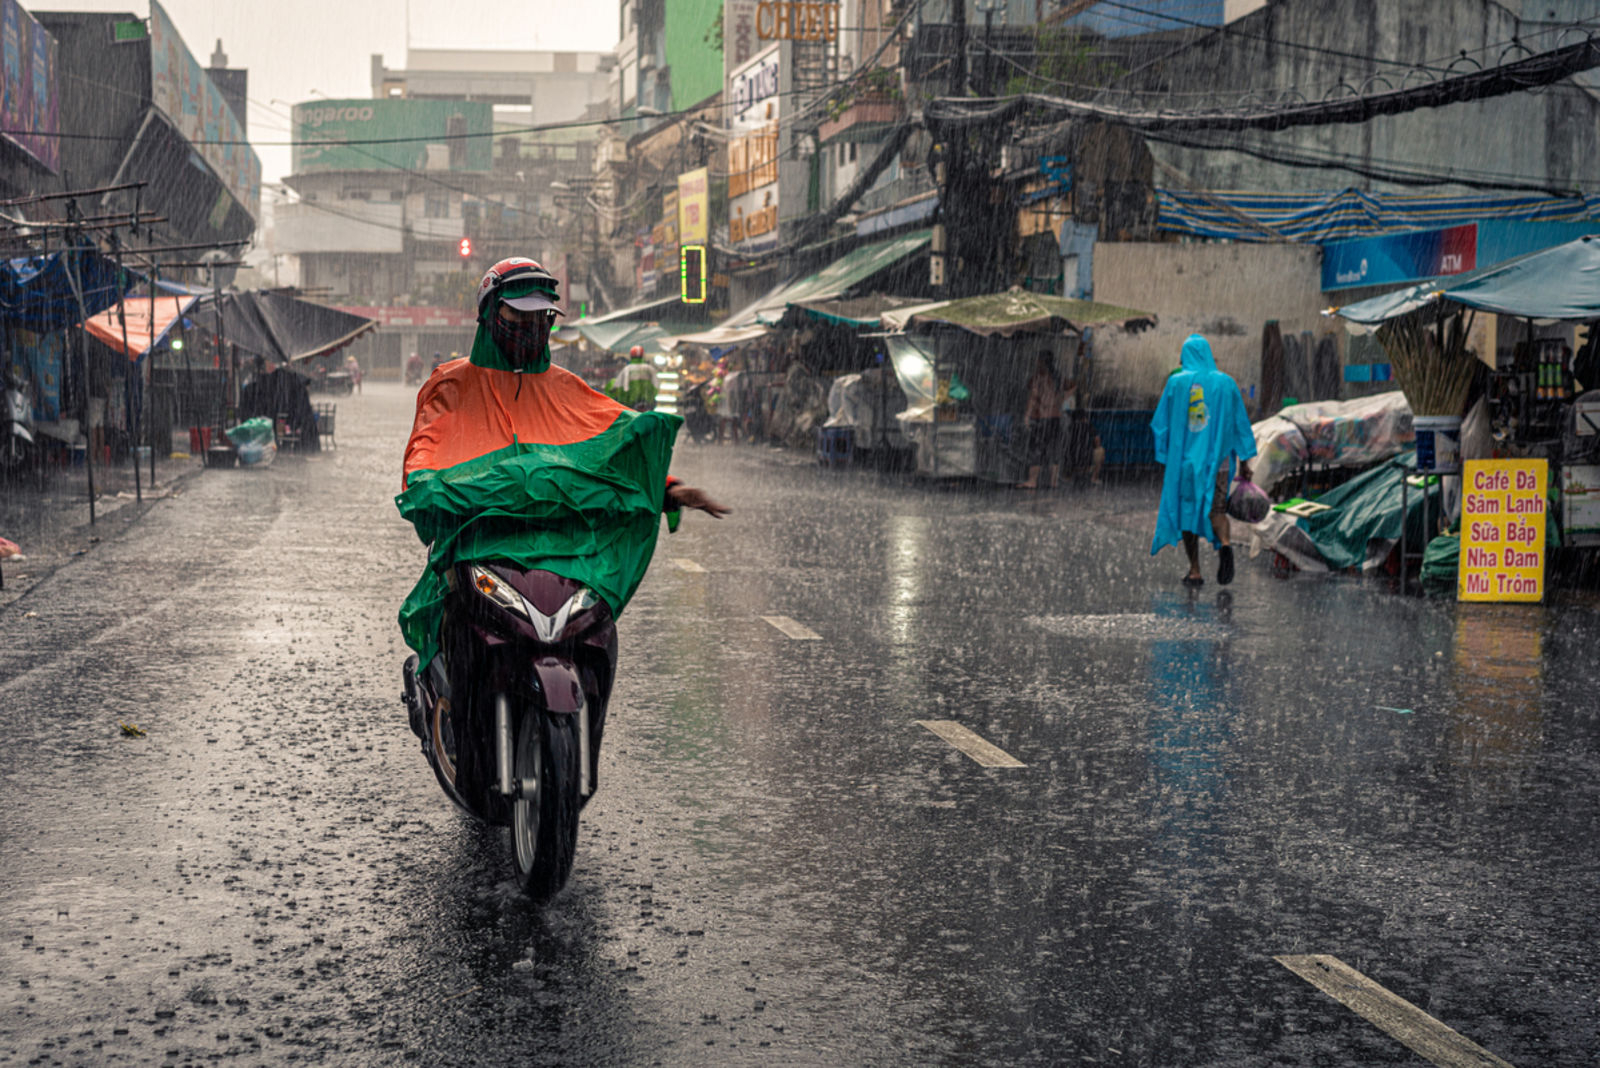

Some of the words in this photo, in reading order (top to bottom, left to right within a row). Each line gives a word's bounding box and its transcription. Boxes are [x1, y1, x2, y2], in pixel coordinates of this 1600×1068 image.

[1440, 254, 1462, 272] ATM
[1474, 470, 1509, 490] Café
[1516, 469, 1536, 490] Đá
[1466, 494, 1499, 513] Sâm
[1506, 494, 1543, 518] Lạnh
[1471, 522, 1499, 542] Sữa
[1507, 516, 1536, 547] Bắp
[1467, 548, 1497, 568] Nha
[1504, 548, 1538, 568] Đam
[1467, 571, 1489, 593] Mủ
[1496, 573, 1537, 593] Trôm
